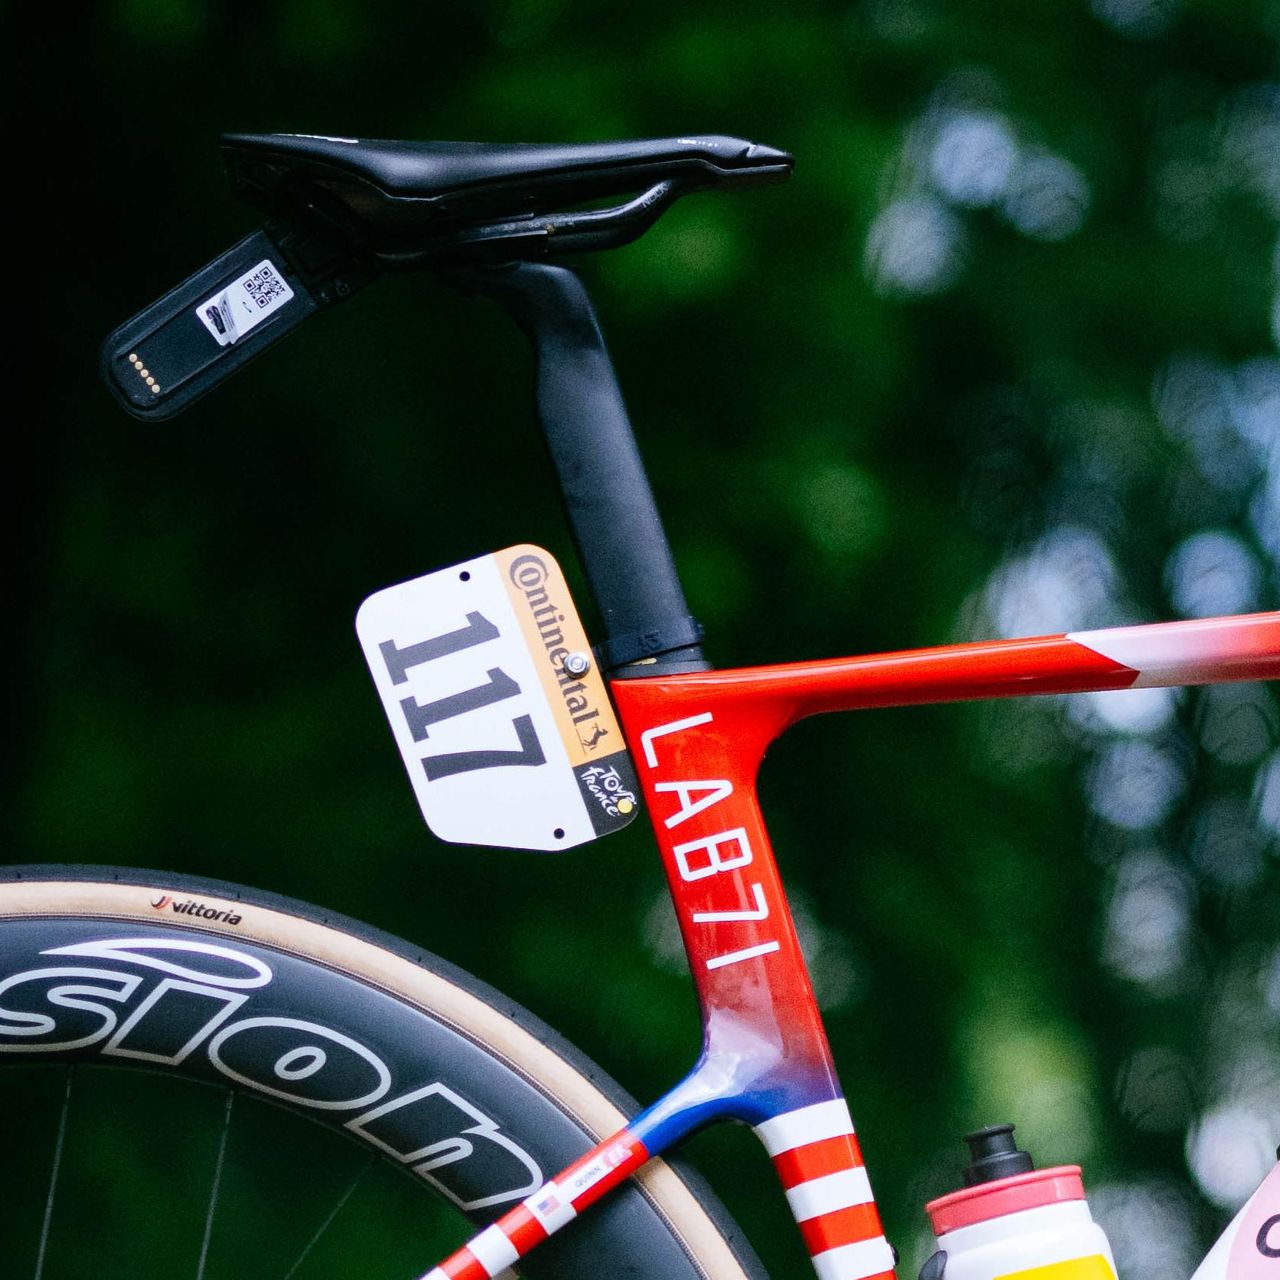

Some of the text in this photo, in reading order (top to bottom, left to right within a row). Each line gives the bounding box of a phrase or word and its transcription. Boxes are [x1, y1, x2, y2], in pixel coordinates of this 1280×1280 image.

[377, 610, 548, 783] 117
[171, 899, 242, 926] vittoria
[641, 711, 781, 970] LAB71
